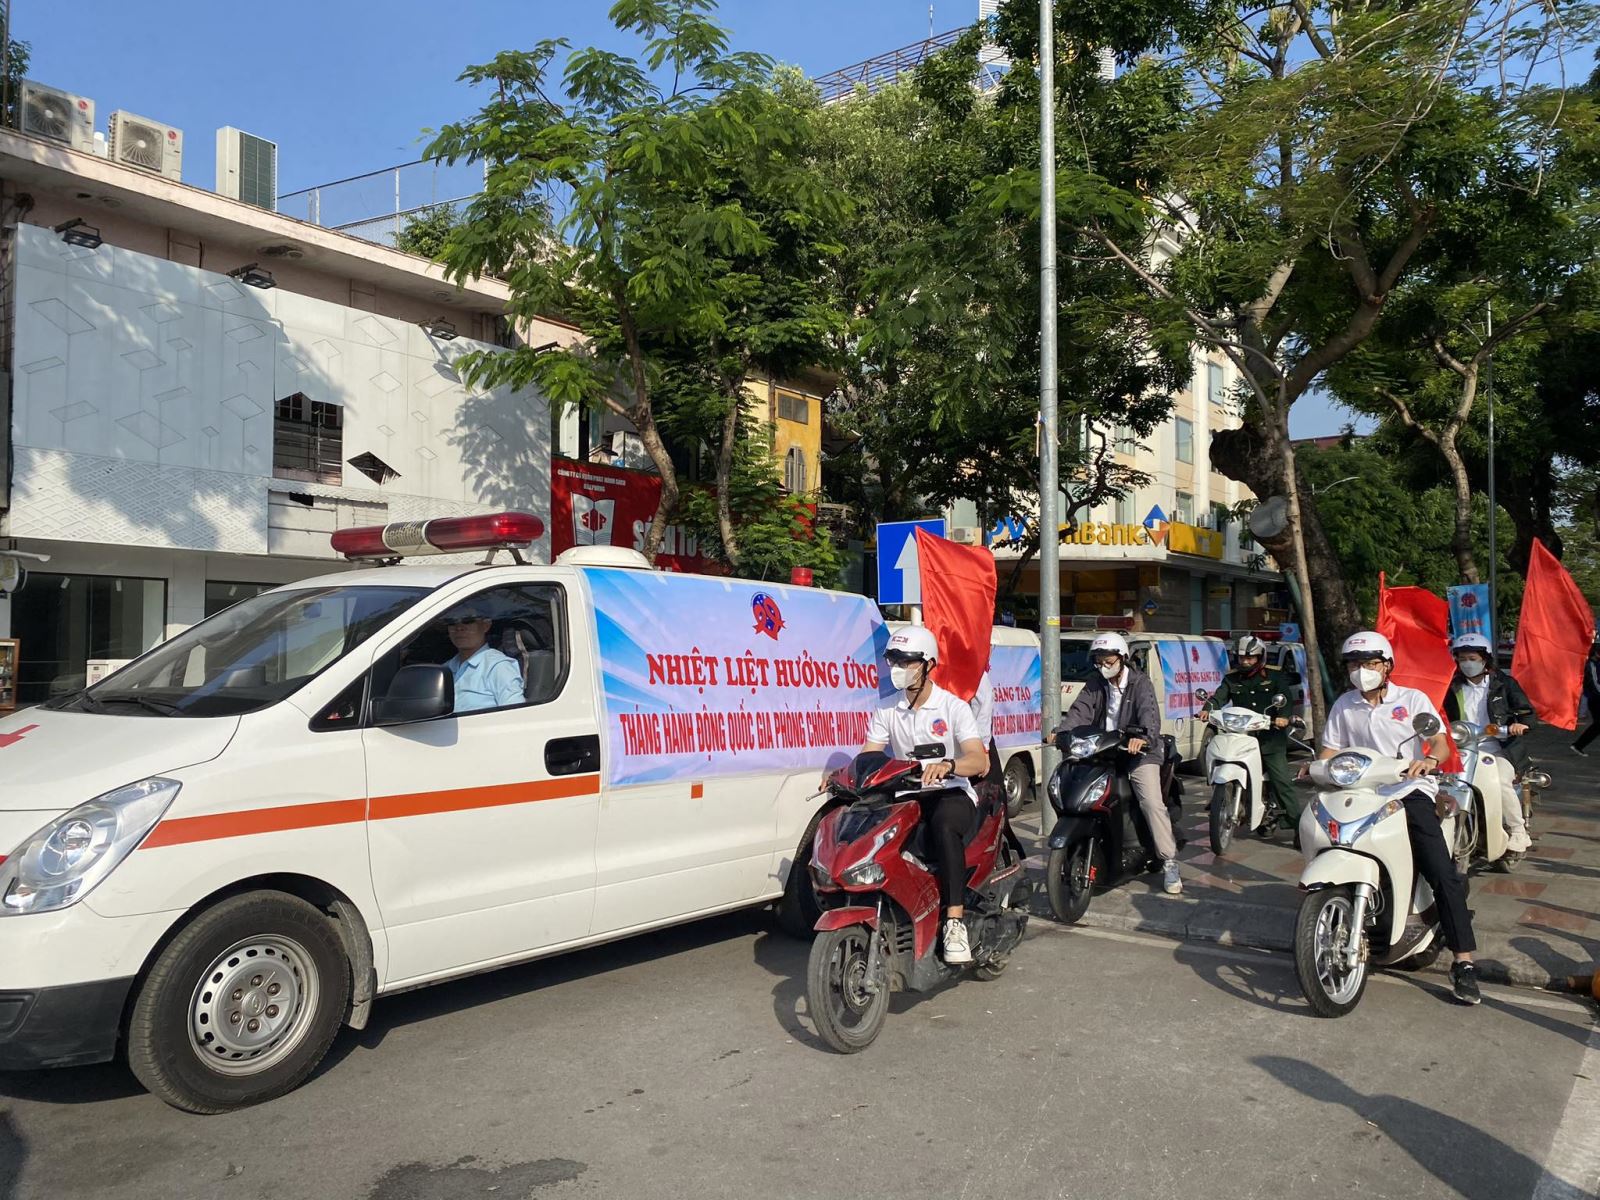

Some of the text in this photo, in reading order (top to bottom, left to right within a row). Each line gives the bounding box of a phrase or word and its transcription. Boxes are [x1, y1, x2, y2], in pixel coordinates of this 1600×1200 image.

[646, 647, 879, 695] NHIỆT LIỆT HƯỞNG ỨNG
[1015, 686, 1031, 705] TẠO
[620, 699, 869, 761] THÁNG HÀNH ĐỘNG QUỐC GIA PHÒNG CHỐNG HIV/AIDS
